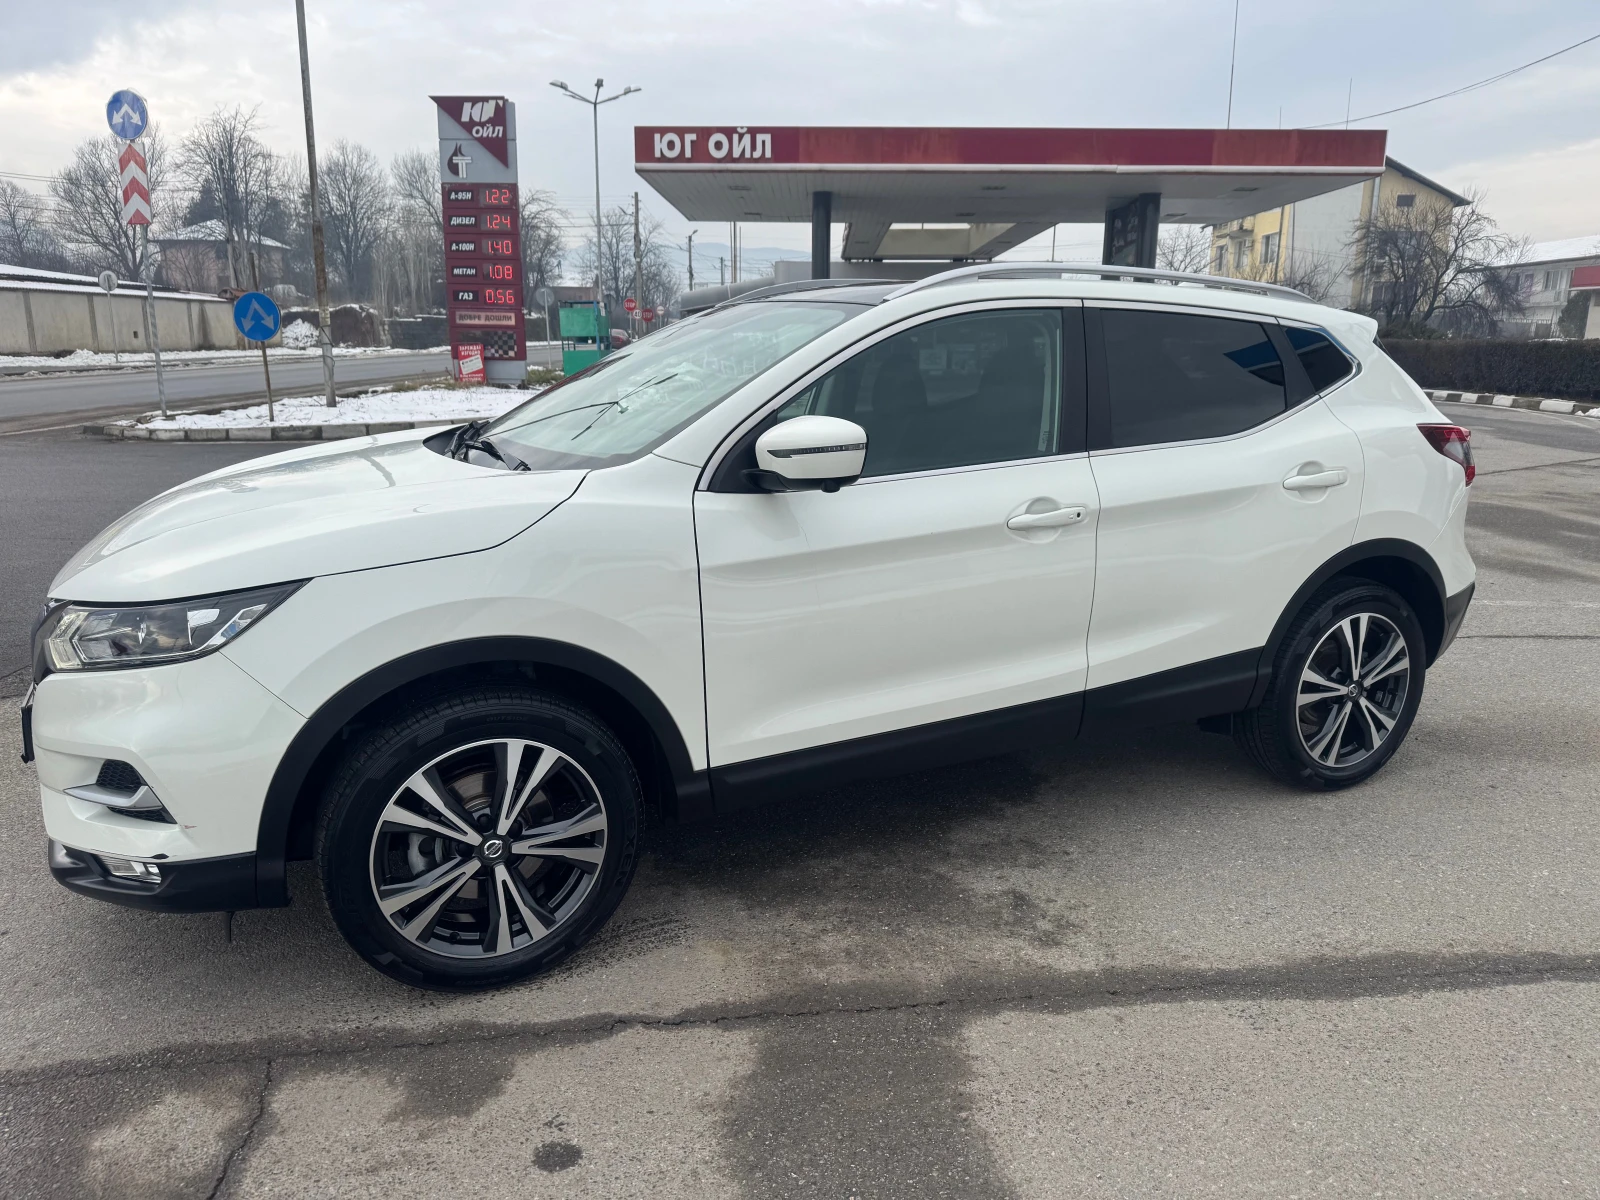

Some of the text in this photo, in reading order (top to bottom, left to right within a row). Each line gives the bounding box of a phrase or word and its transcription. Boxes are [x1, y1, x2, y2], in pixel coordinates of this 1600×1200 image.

[472, 123, 504, 138] ОЙЛ
[653, 126, 772, 159] ЮГ ОЙЛ
[485, 189, 511, 204] 1.22
[450, 214, 511, 229] ДИЗЕЛ 1.24
[488, 240, 513, 254] 1.40
[489, 265, 513, 279] 1.08
[458, 290, 515, 304] ГАЗ 0.56
[458, 313, 513, 322] ДОБРЕ ДОШЛИ
